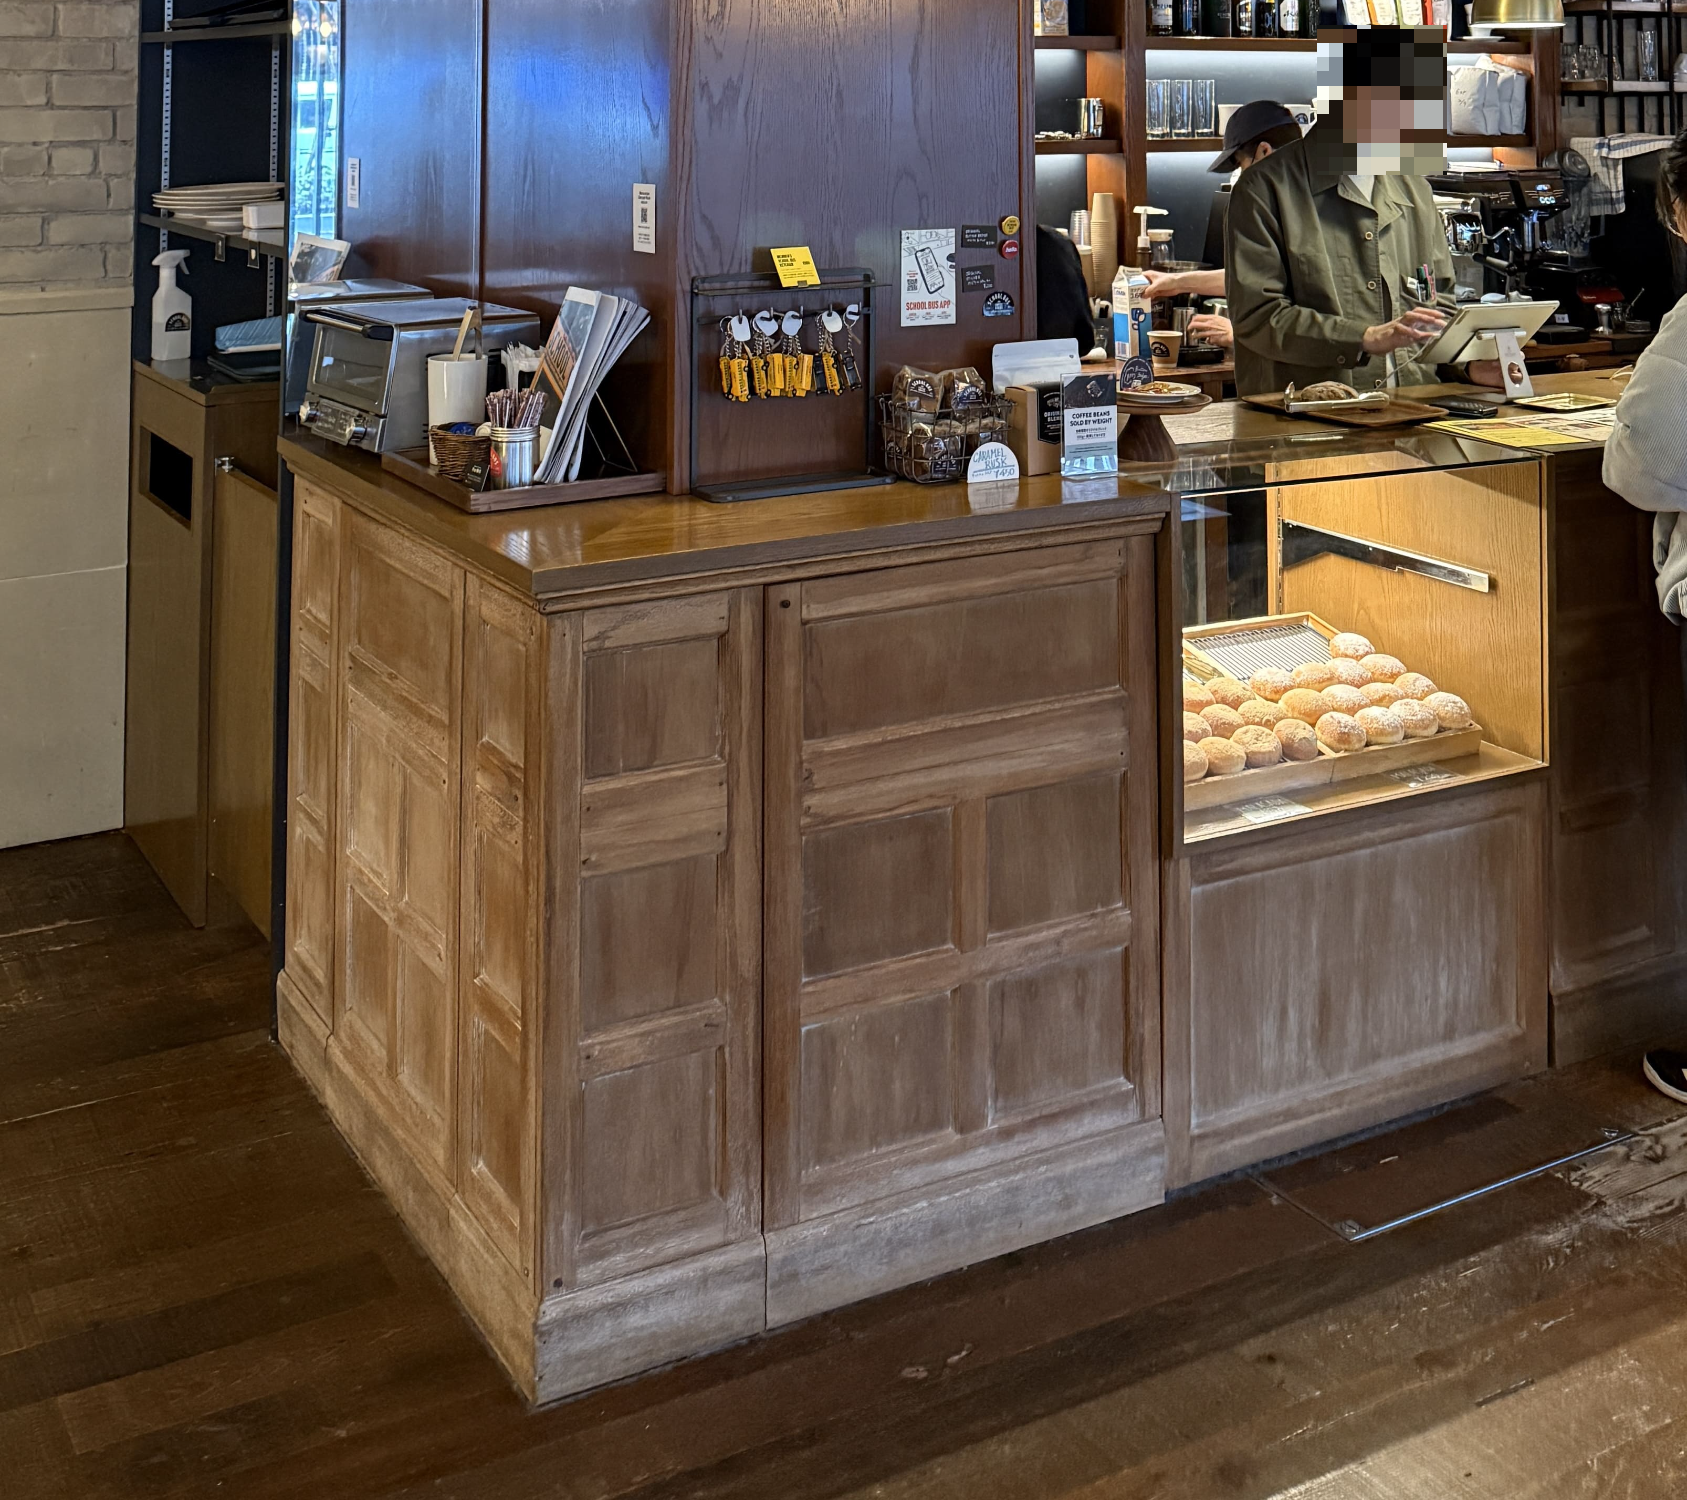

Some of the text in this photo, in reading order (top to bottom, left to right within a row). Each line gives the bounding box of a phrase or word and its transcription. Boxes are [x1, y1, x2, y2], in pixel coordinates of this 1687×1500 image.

[905, 299, 951, 311] SCHOOL BUS APP
[987, 292, 1003, 306] SCHOOL
[1071, 410, 1110, 420] COFFEE BEANS
[1091, 417, 1113, 425] WEIGHT
[972, 447, 1007, 463] CARAMEL
[984, 457, 1007, 470] RUSK
